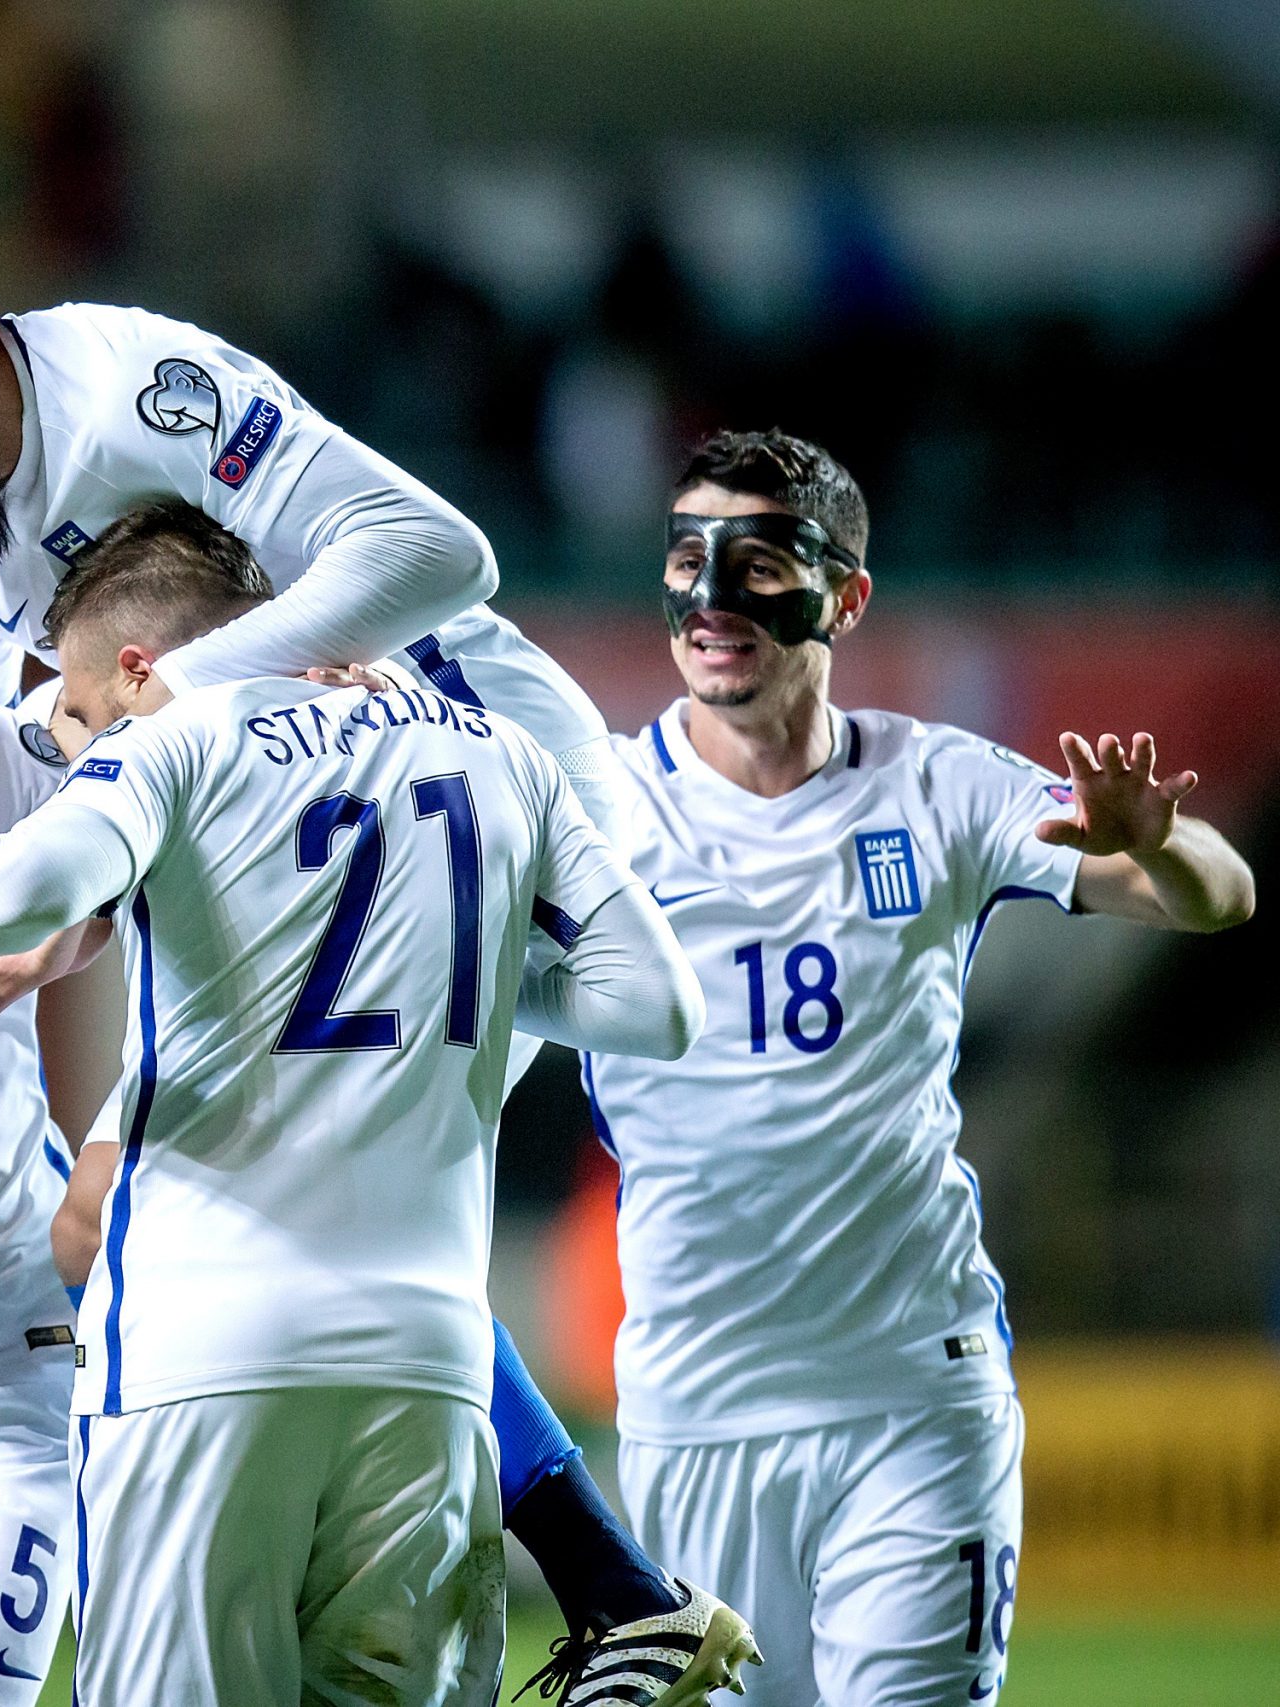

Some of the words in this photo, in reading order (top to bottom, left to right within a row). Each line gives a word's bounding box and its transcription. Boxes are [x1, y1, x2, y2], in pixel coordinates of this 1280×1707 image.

[236, 400, 278, 459] RESPECT
[271, 771, 484, 1056] 21
[734, 941, 845, 1055] 18
[0, 1522, 58, 1634] 5
[958, 1538, 1017, 1657] 18
